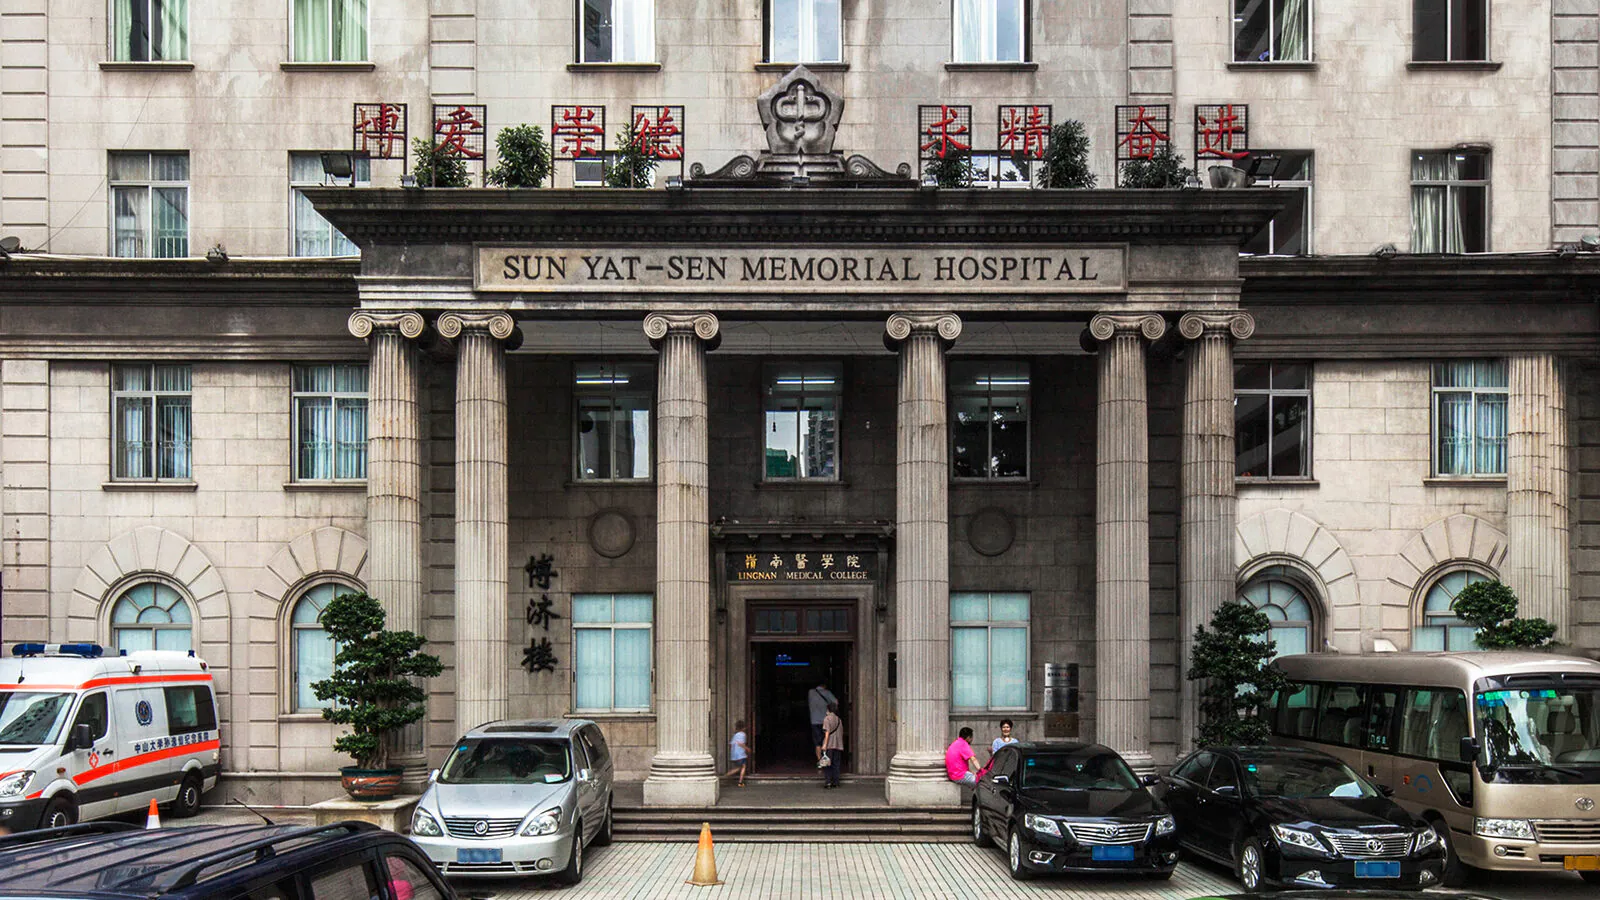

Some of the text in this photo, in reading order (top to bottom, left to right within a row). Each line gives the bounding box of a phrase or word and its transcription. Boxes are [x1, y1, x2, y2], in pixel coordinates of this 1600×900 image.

[503, 255, 567, 281] SUN
[740, 256, 921, 282] MEMORIAL
[933, 256, 1099, 282] HOSPITAL
[738, 571, 868, 580] LINGNAN MEDICAL COLLEGE
